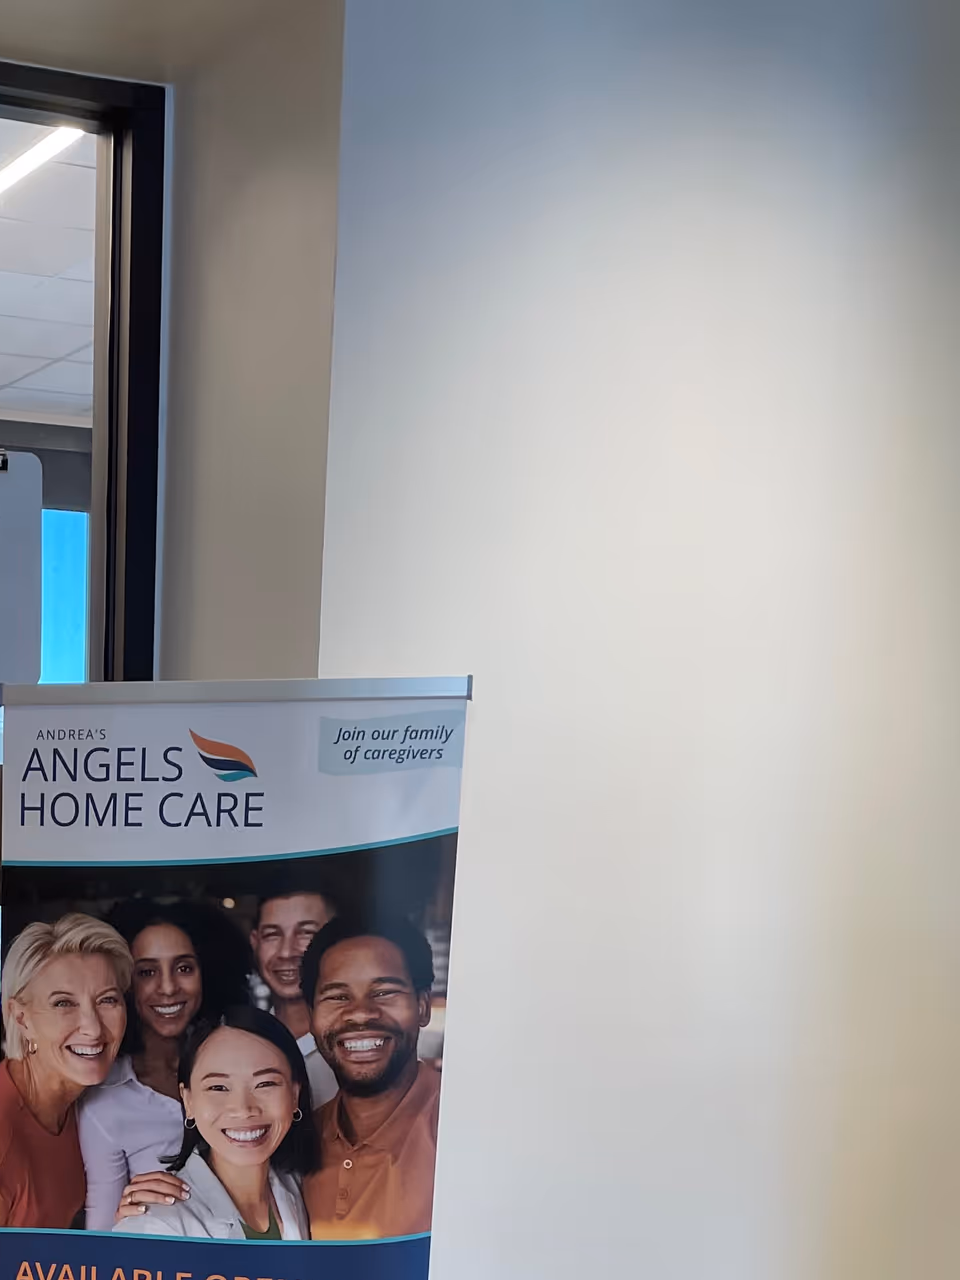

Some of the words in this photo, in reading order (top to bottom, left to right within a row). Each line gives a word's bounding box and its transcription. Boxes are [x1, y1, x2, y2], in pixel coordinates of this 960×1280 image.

[36, 728, 107, 741] ANDREA'S
[333, 726, 366, 744] Join
[371, 728, 400, 741] our
[399, 725, 454, 745] family
[21, 746, 184, 783] ANGELS
[343, 745, 361, 764] of
[363, 745, 444, 764] caregivers
[19, 792, 143, 828] HOME
[158, 791, 265, 828] CARE
